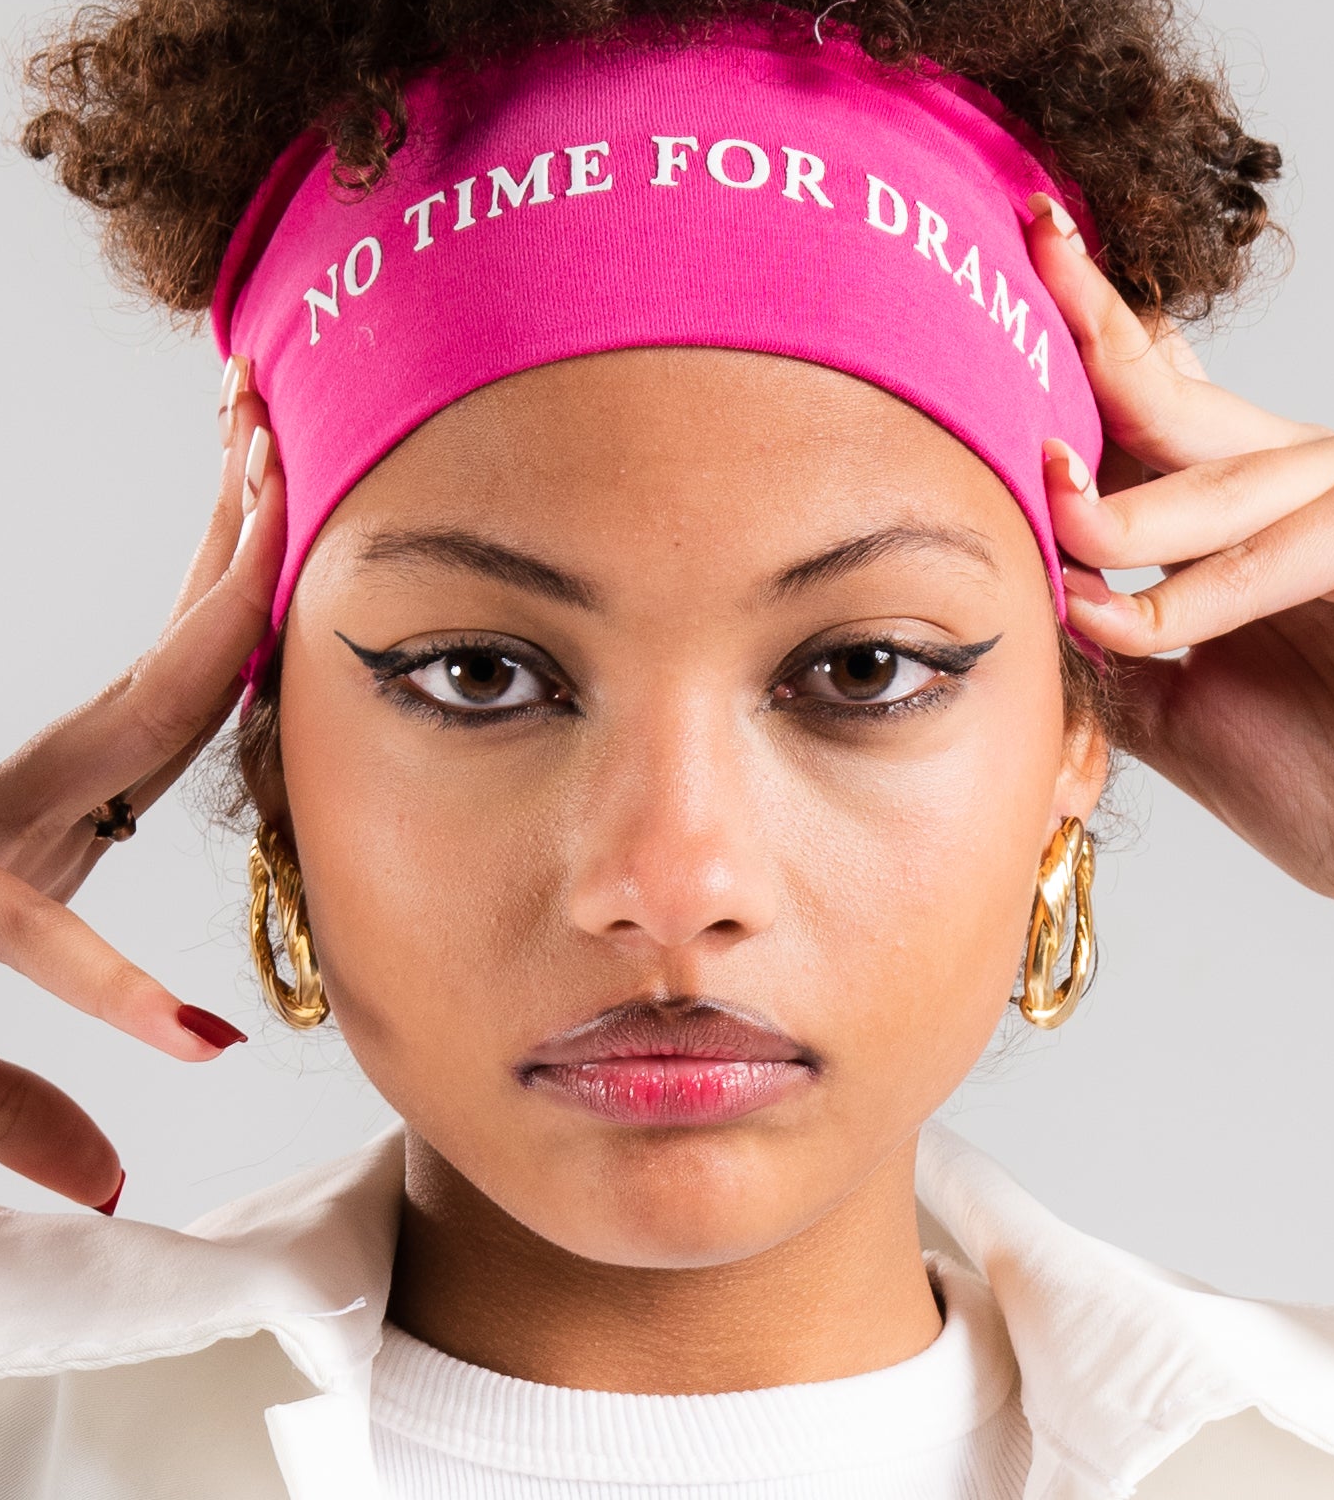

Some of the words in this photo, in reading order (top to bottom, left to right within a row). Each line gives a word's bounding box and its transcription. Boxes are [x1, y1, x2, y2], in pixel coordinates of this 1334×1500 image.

[302, 235, 383, 347] NO
[404, 140, 614, 253] TIME
[650, 135, 835, 209] FOR
[863, 173, 1052, 394] DRAMA
